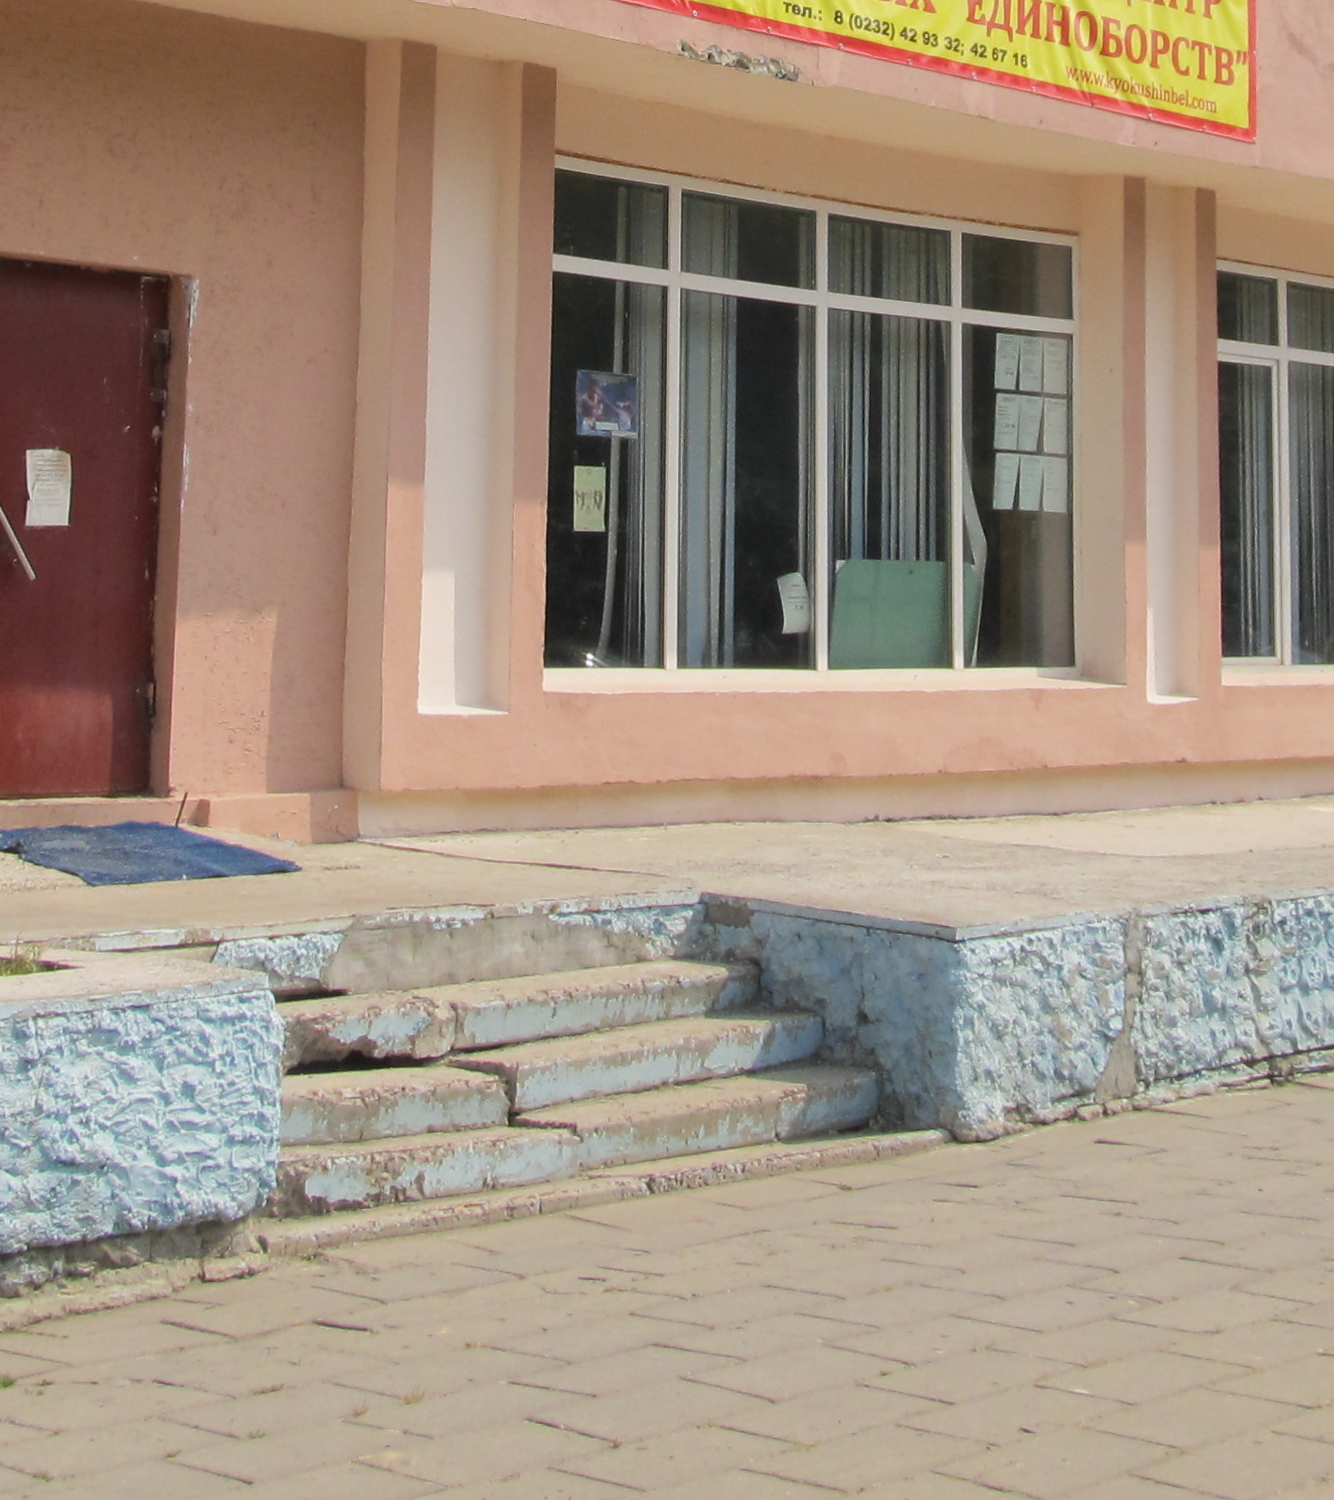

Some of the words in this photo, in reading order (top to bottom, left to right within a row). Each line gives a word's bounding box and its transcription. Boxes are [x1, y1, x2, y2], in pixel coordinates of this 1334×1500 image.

[783, 1, 823, 21] тел.:
[834, 10, 844, 25] 8
[849, 13, 895, 41] (0232)
[899, 26, 918, 43] 42
[922, 31, 939, 47] 93
[944, 36, 965, 56] 32;
[970, 42, 988, 58] 42
[991, 47, 1008, 63] 67
[1012, 52, 1028, 68] 16
